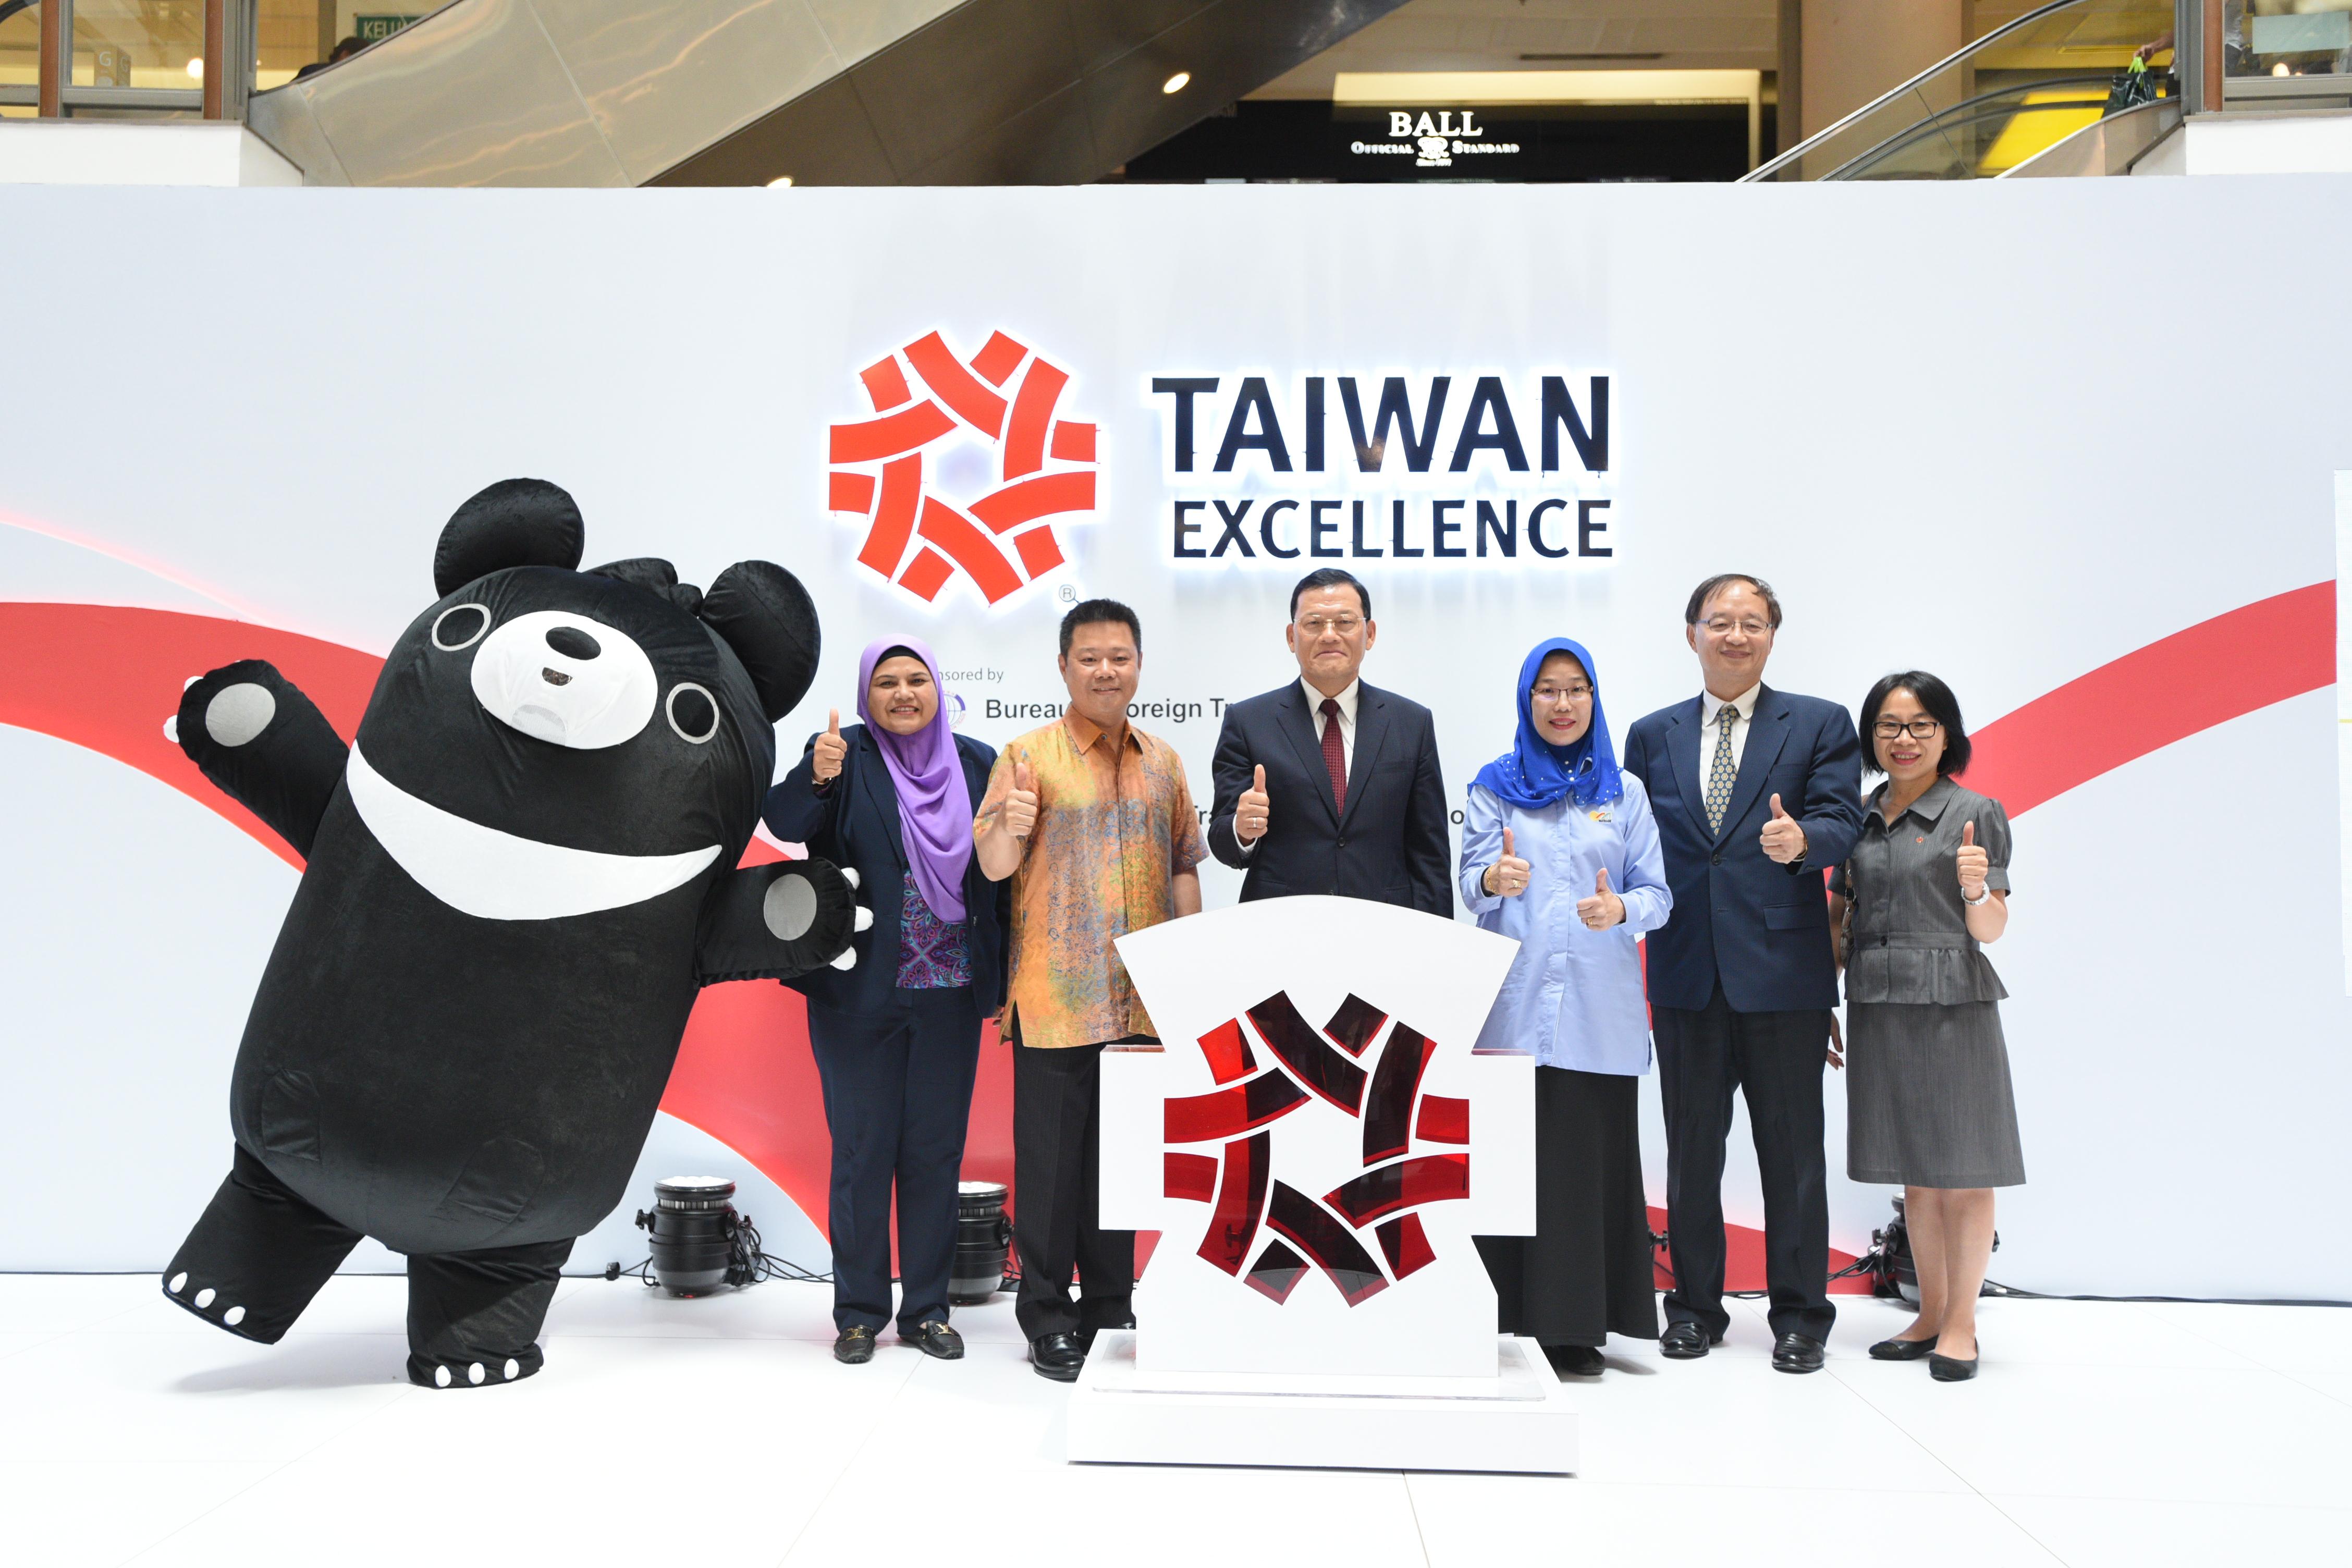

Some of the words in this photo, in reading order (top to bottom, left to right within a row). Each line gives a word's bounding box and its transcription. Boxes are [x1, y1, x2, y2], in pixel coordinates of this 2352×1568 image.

[1389, 111, 1483, 137] BALL
[1152, 376, 1609, 473] TAIWAN
[1173, 499, 1613, 558] EXCELLENCE
[939, 667, 983, 681] nsored
[987, 667, 1004, 683] by
[1126, 698, 1202, 723] oreign
